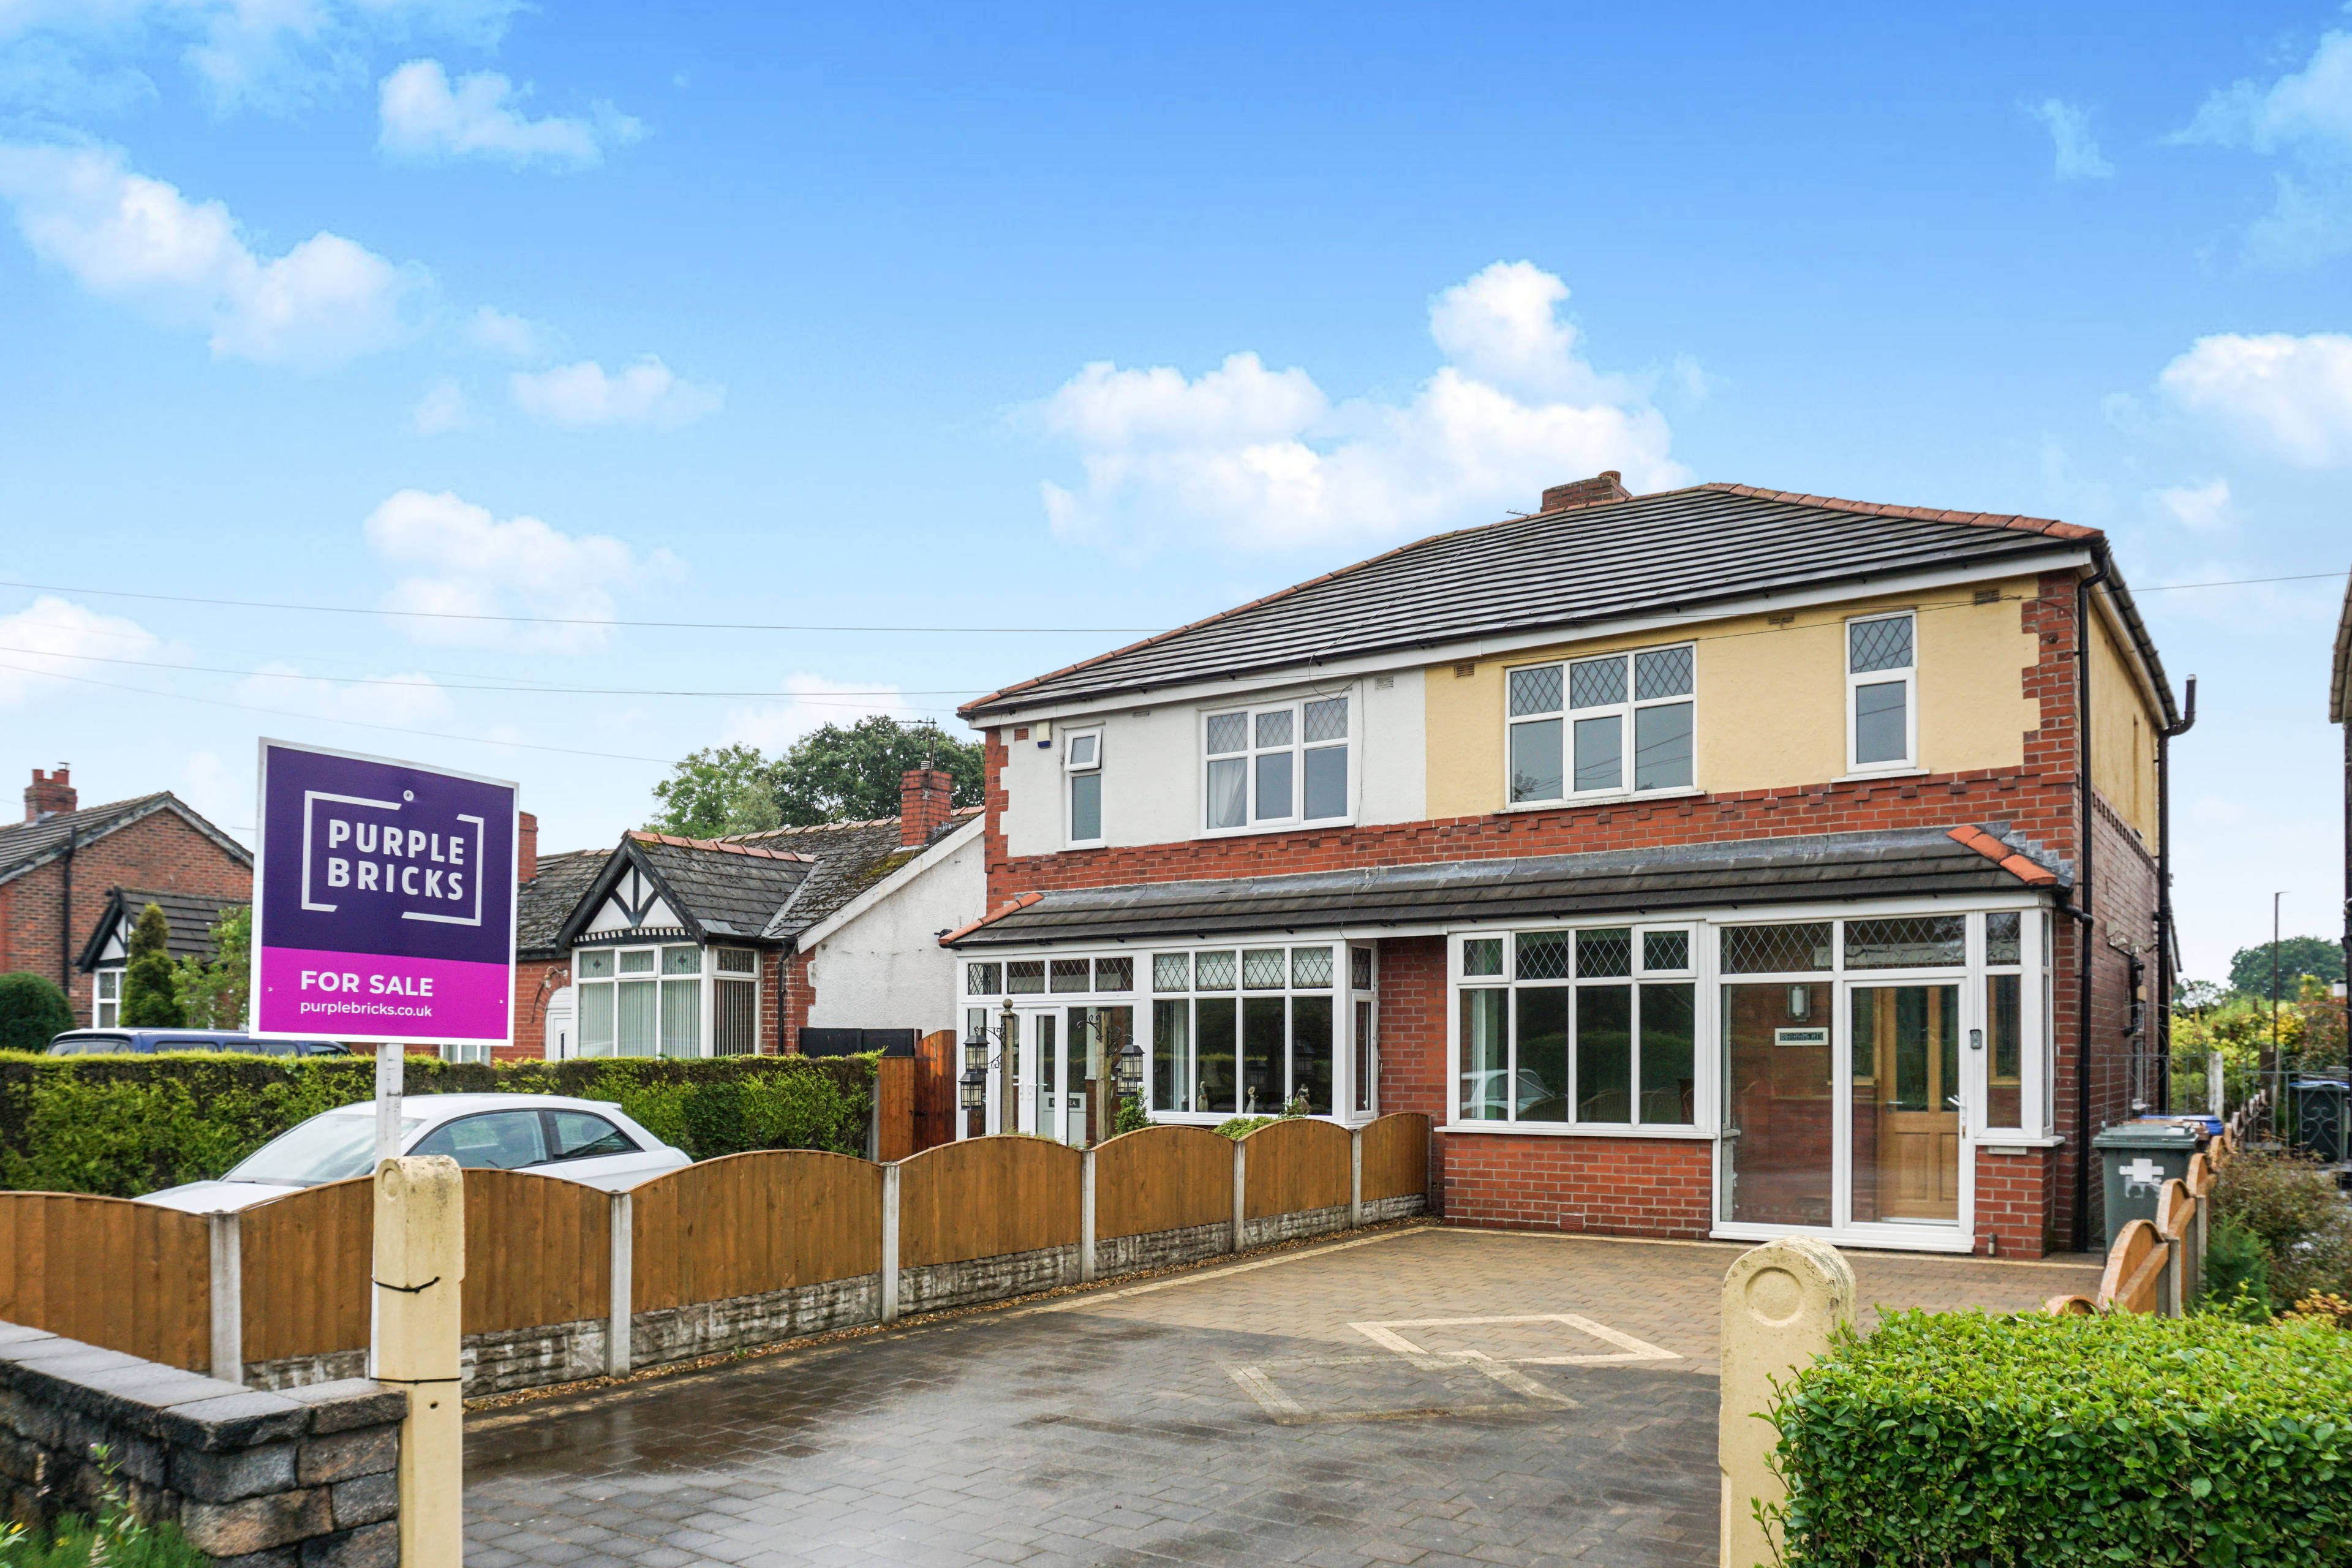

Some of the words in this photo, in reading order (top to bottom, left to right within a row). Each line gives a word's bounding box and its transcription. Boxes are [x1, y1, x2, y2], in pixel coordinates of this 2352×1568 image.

[329, 819, 464, 865] PURPLE
[328, 858, 463, 900] BRICKS
[301, 970, 360, 993] FOR
[369, 974, 434, 997] SALE
[300, 1001, 432, 1017] purplebricks.co.uk
